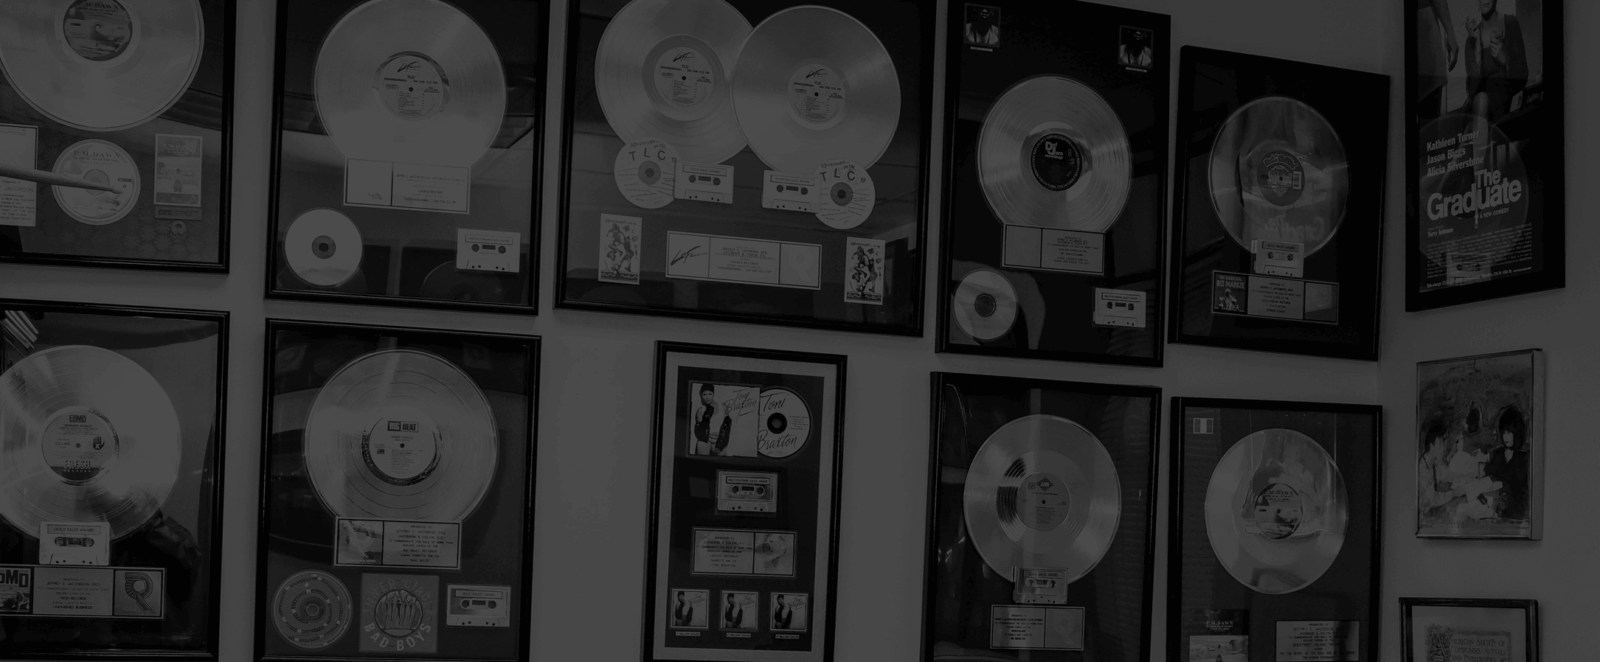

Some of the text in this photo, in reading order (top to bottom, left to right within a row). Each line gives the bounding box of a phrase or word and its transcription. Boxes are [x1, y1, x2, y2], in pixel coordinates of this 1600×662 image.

[1426, 130, 1480, 152] Kathleen Turner
[1426, 147, 1466, 165] Jason Biggs
[1426, 156, 1484, 178] Alicia Silverstone
[1474, 169, 1501, 189] The
[1426, 177, 1522, 221] Graduate
[1493, 207, 1510, 216] COMEDY
[760, 391, 790, 412] Toni
[388, 422, 417, 431] BIG BEAT
[758, 429, 798, 451] Braxton
[64, 460, 91, 470] FRESH
[363, 622, 390, 649] BAD
[396, 622, 432, 652] BOYS
